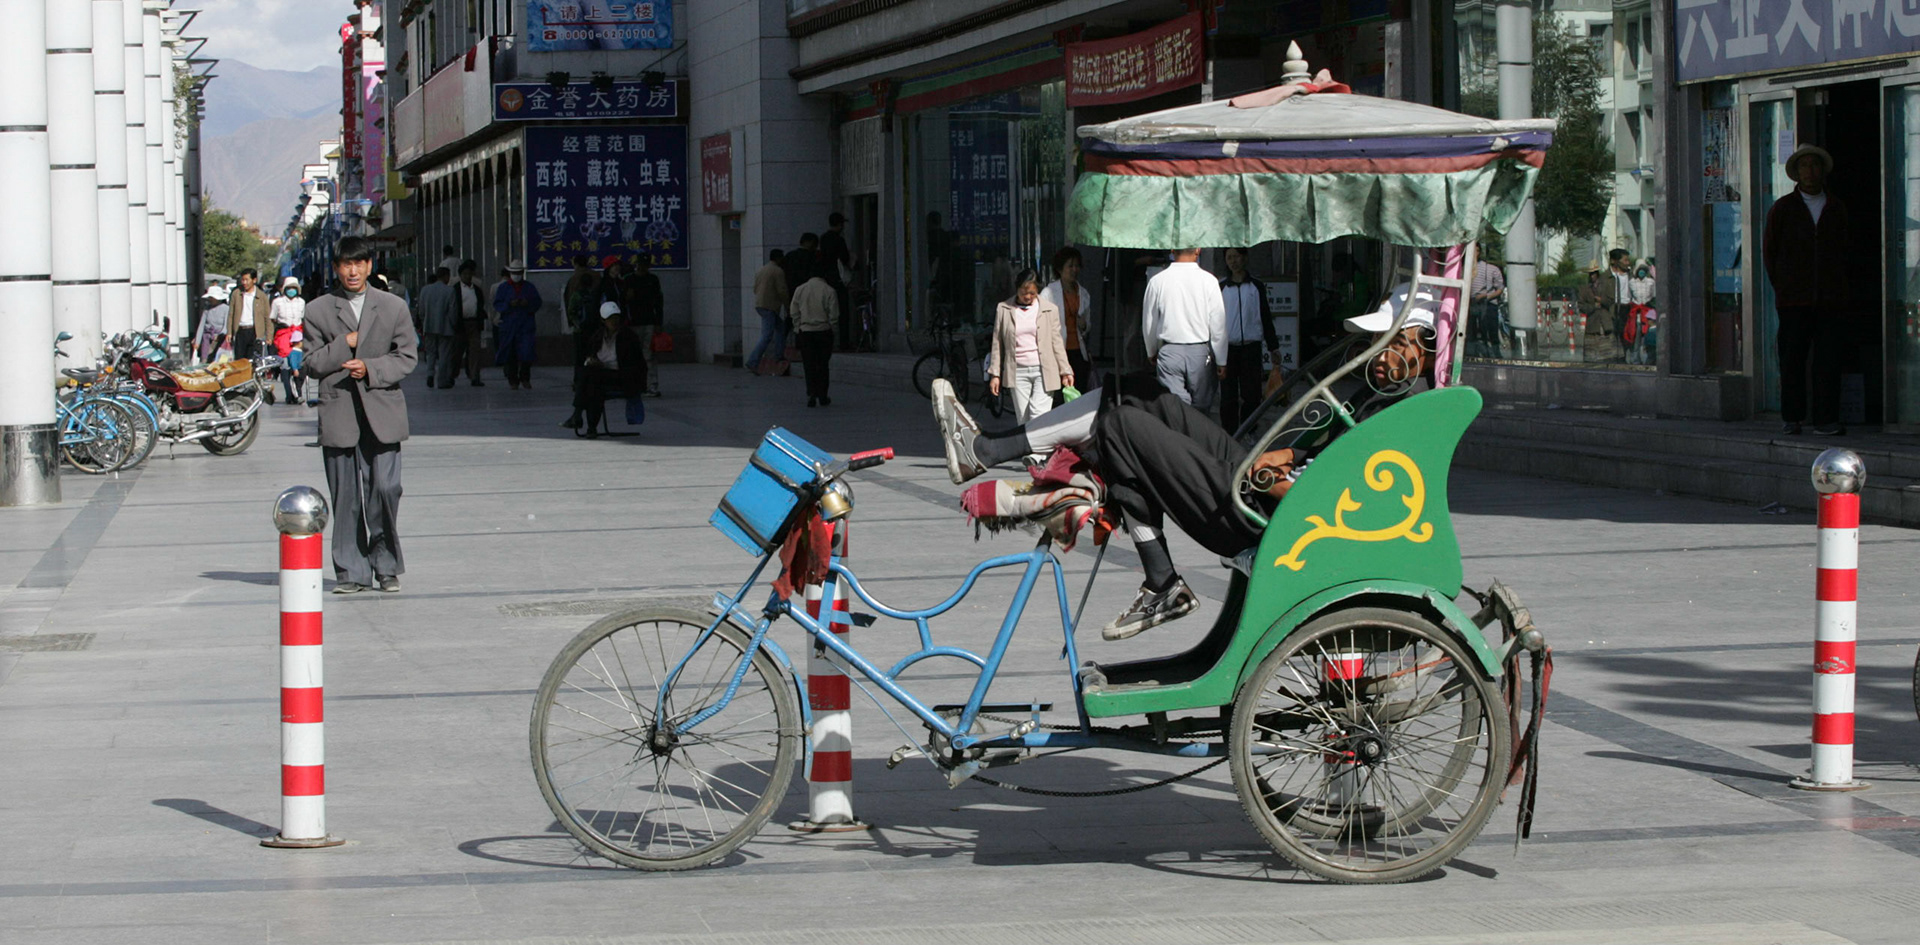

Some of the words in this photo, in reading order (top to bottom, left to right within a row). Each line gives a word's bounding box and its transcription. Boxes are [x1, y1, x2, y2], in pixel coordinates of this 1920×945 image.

[560, 3, 654, 20] 请上二楼
[527, 84, 671, 110] 金誉大药房
[562, 134, 646, 153] 经营范围
